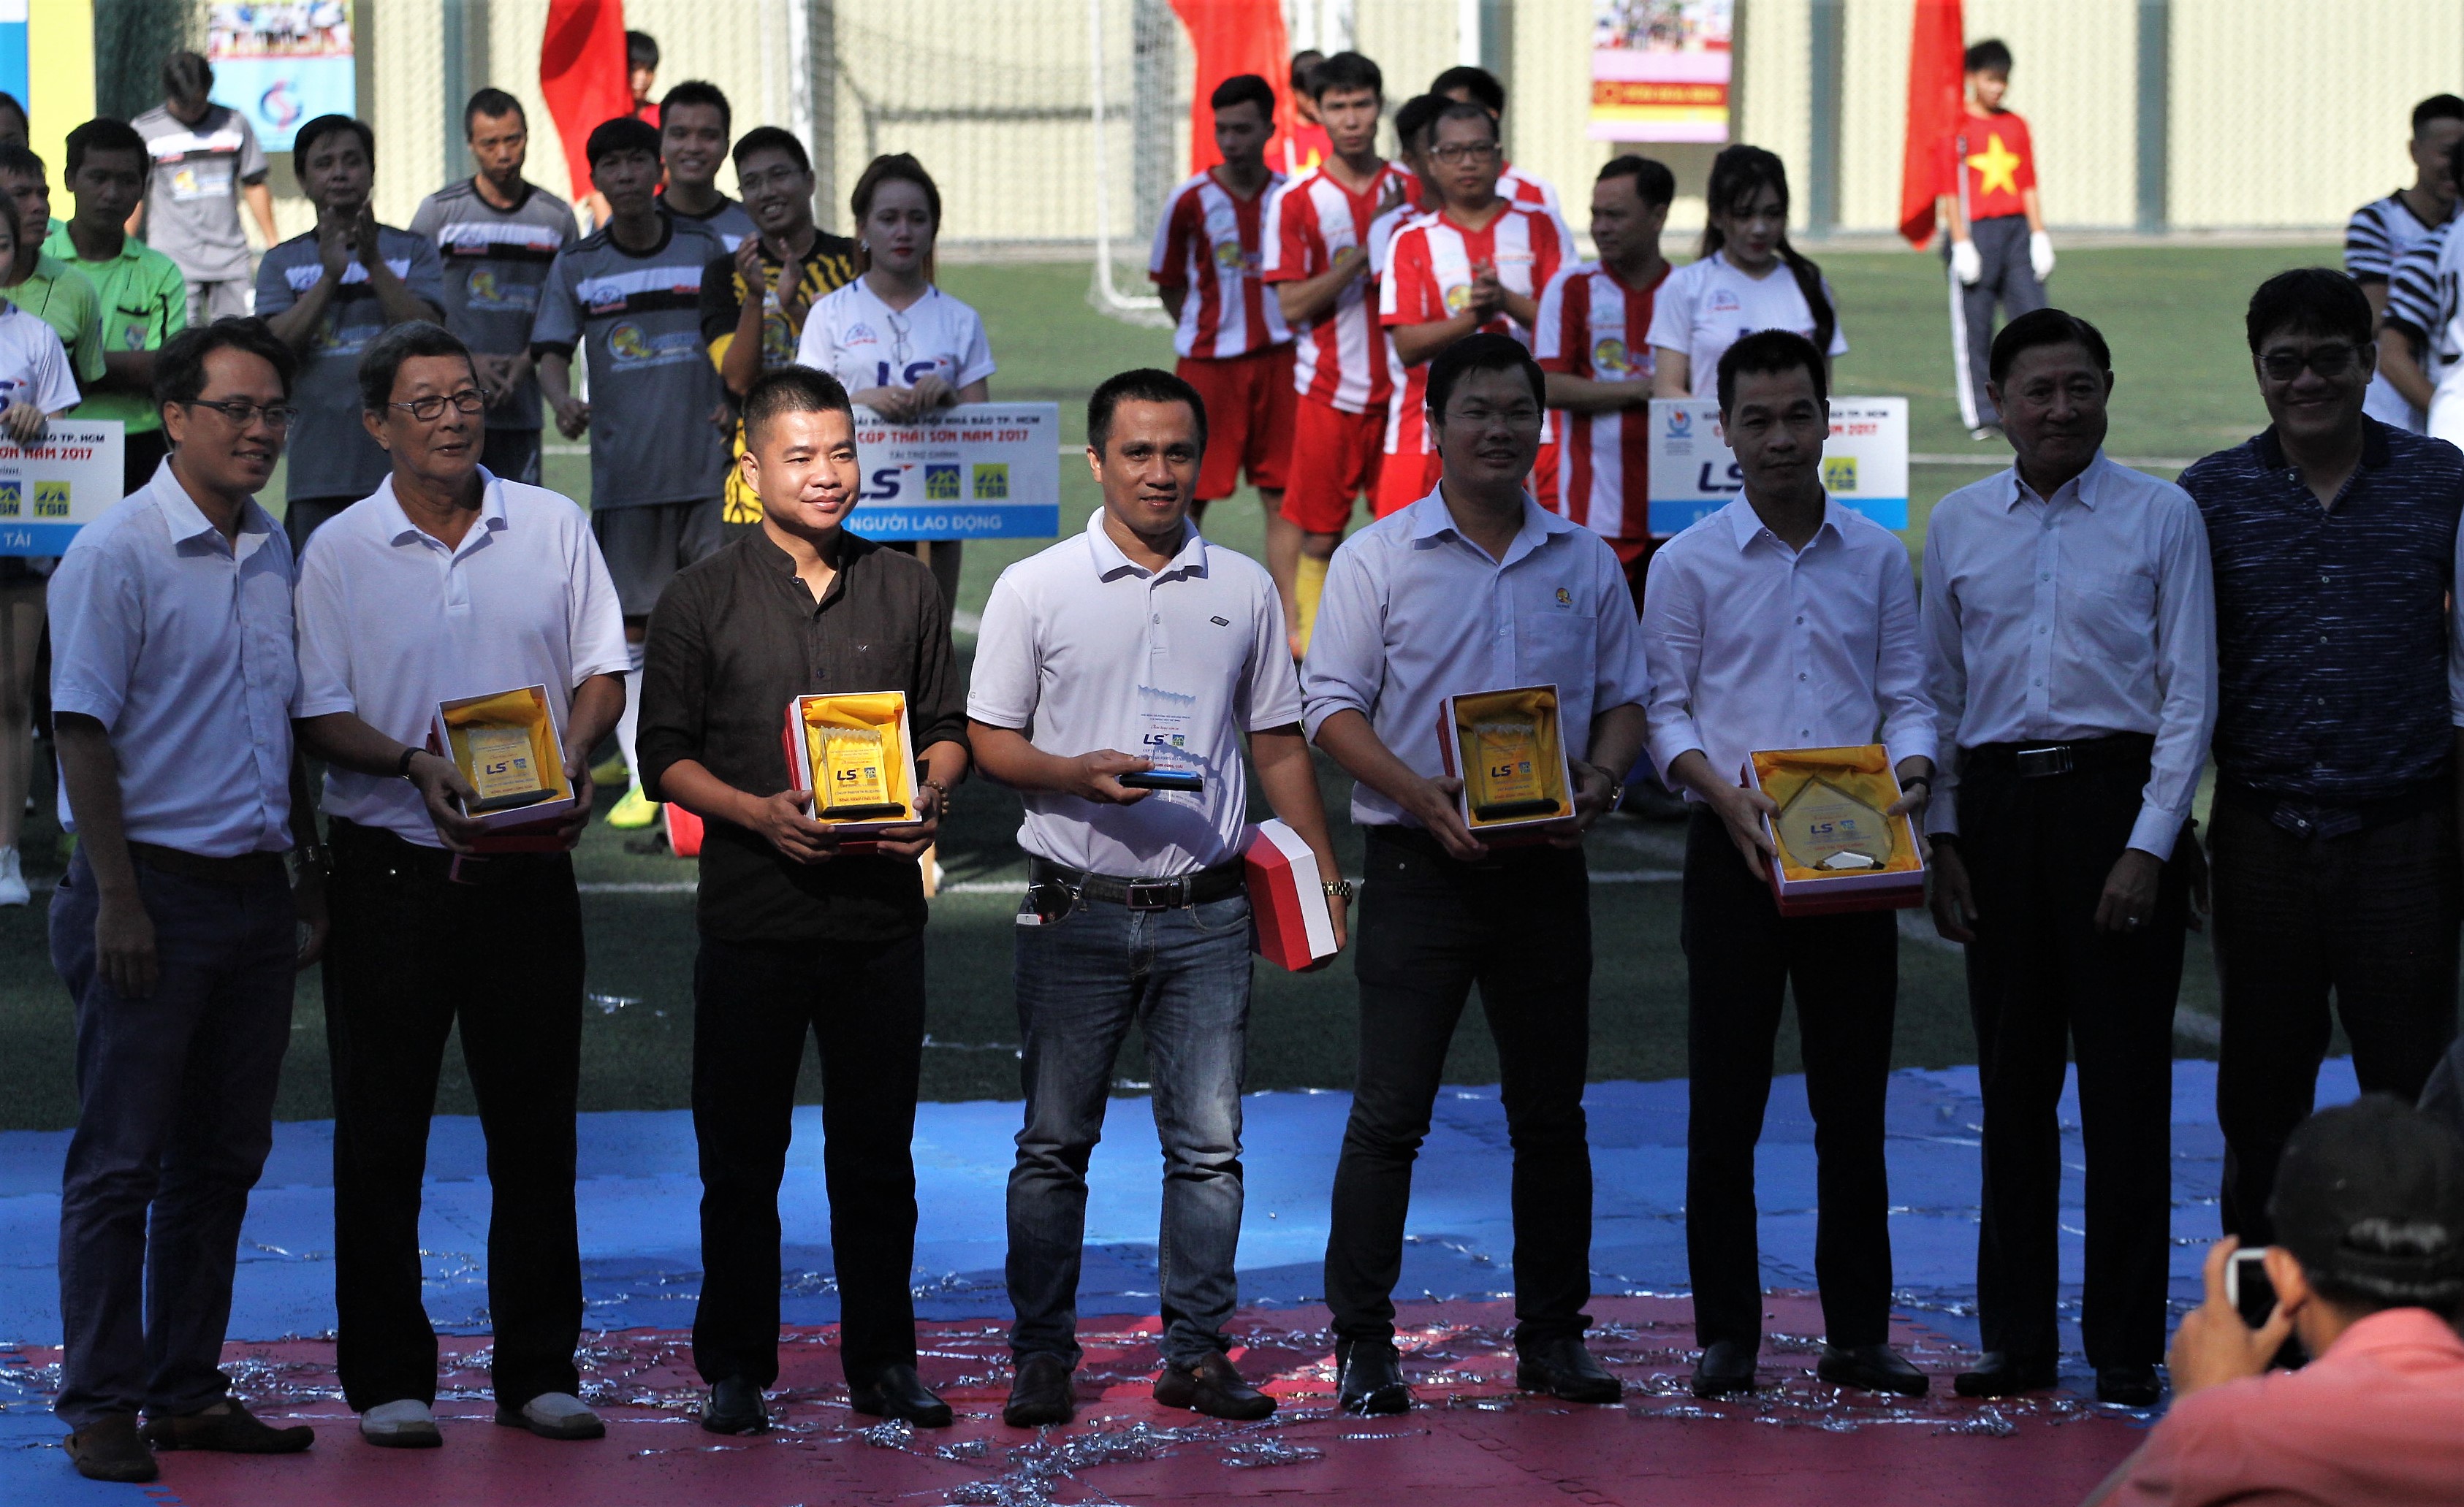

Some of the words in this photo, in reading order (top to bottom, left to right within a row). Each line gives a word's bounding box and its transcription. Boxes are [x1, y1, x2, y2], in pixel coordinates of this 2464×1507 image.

[80, 432, 105, 443] HCM
[998, 429, 1029, 442] 2017
[61, 447, 93, 461] 2017
[929, 486, 959, 498] TSN
[974, 486, 1007, 498] TSB
[0, 503, 19, 515] SN
[36, 503, 68, 516] TSB
[849, 514, 908, 532] NGƯỜI
[913, 515, 948, 531] LAO
[1143, 733, 1165, 745] LS
[486, 763, 507, 775] LS
[837, 769, 857, 781] LS
[1491, 765, 1511, 778] LS
[1810, 823, 1833, 834] LS
